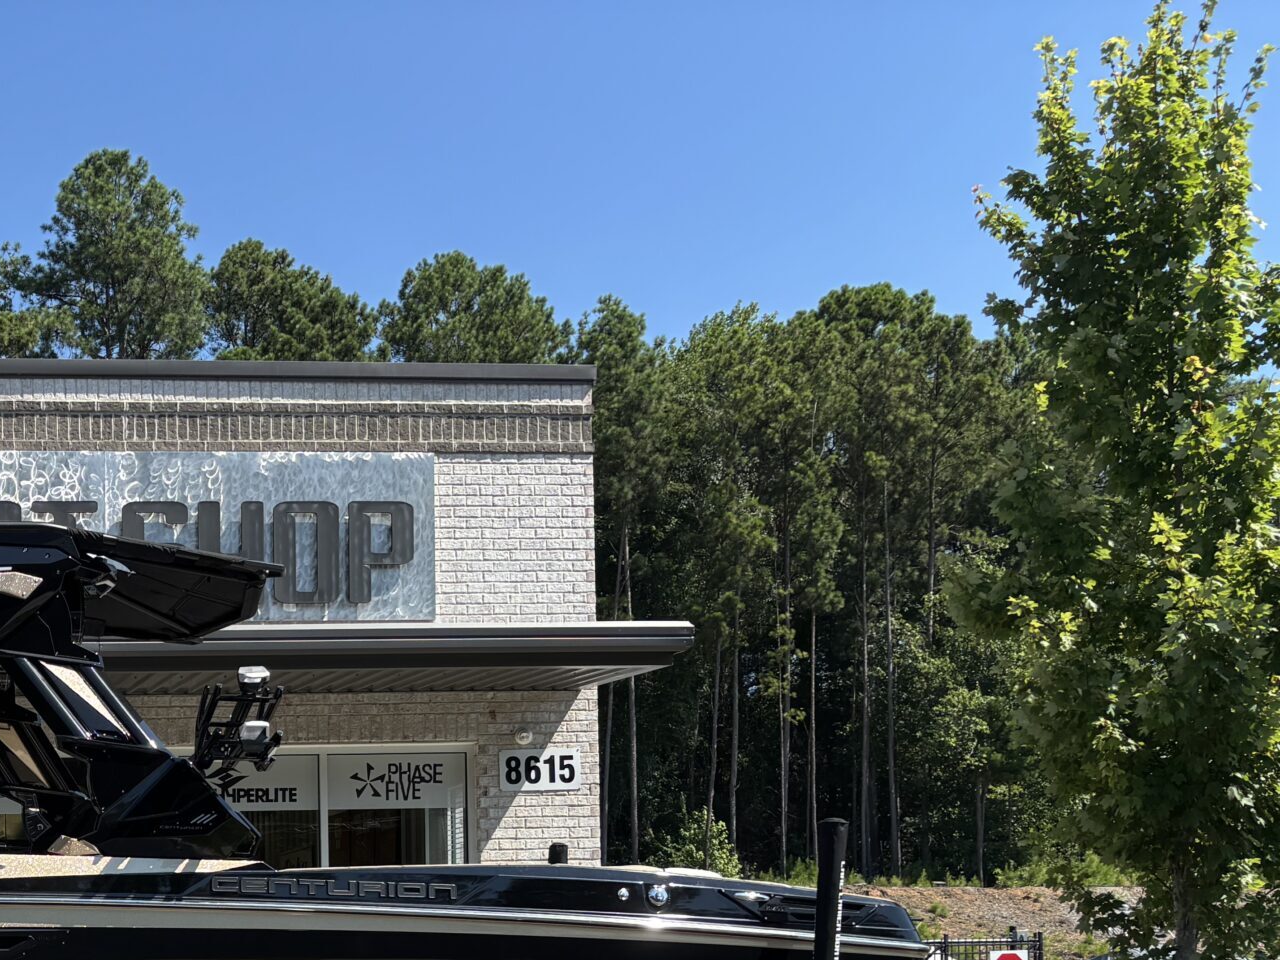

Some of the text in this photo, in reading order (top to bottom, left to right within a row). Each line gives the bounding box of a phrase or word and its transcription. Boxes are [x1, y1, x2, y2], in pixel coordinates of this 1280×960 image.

[386, 763, 443, 784] PHASE
[505, 755, 575, 785] 8615
[386, 781, 421, 800] FIVE
[212, 876, 457, 900] CENTURION
